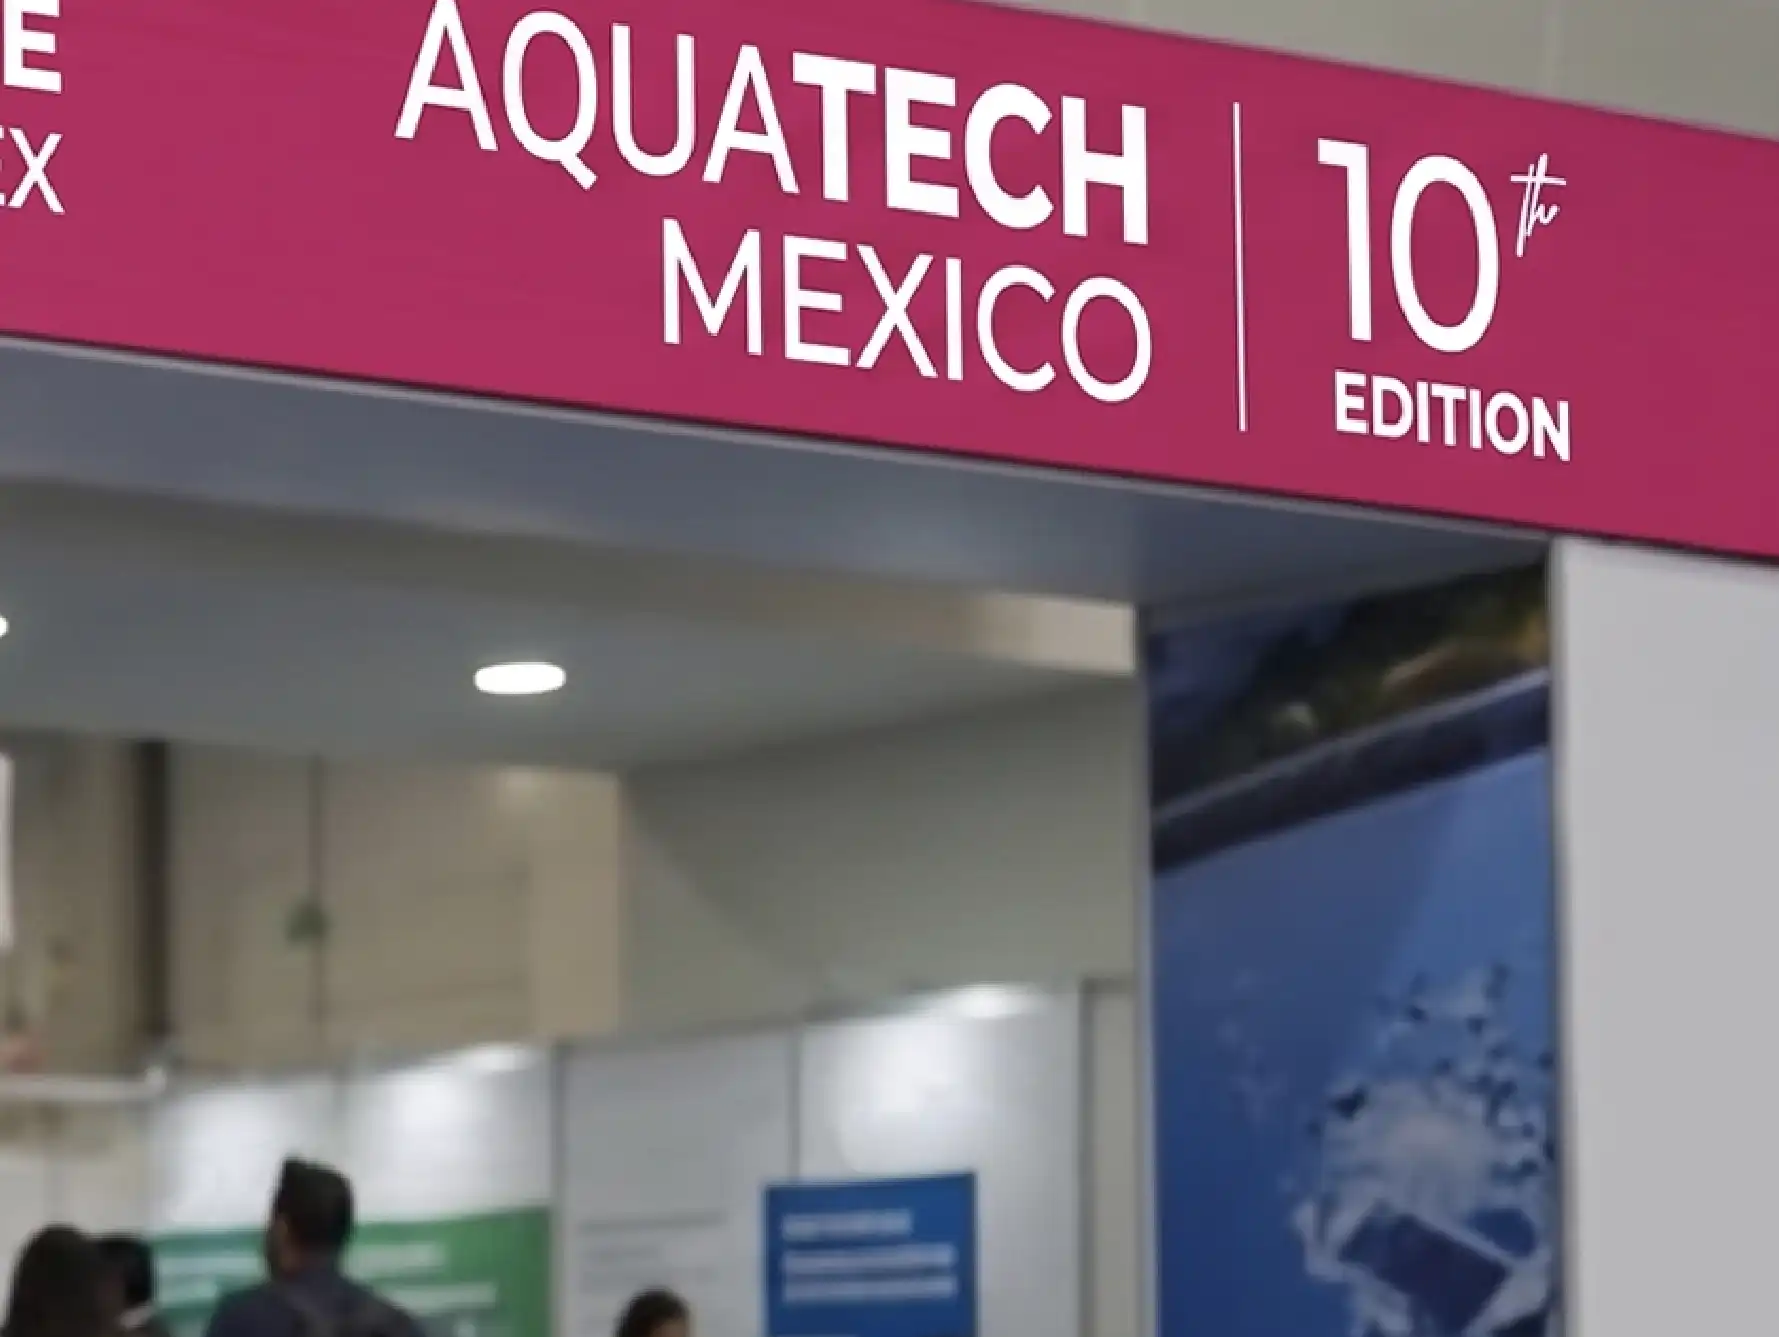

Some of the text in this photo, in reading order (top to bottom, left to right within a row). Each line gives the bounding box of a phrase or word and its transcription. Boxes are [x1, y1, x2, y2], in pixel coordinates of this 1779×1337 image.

[0, 124, 65, 214] X
[395, 0, 1149, 245] AQUATECH
[662, 218, 1152, 403] MEXICO
[1334, 371, 1571, 463] EDITION
